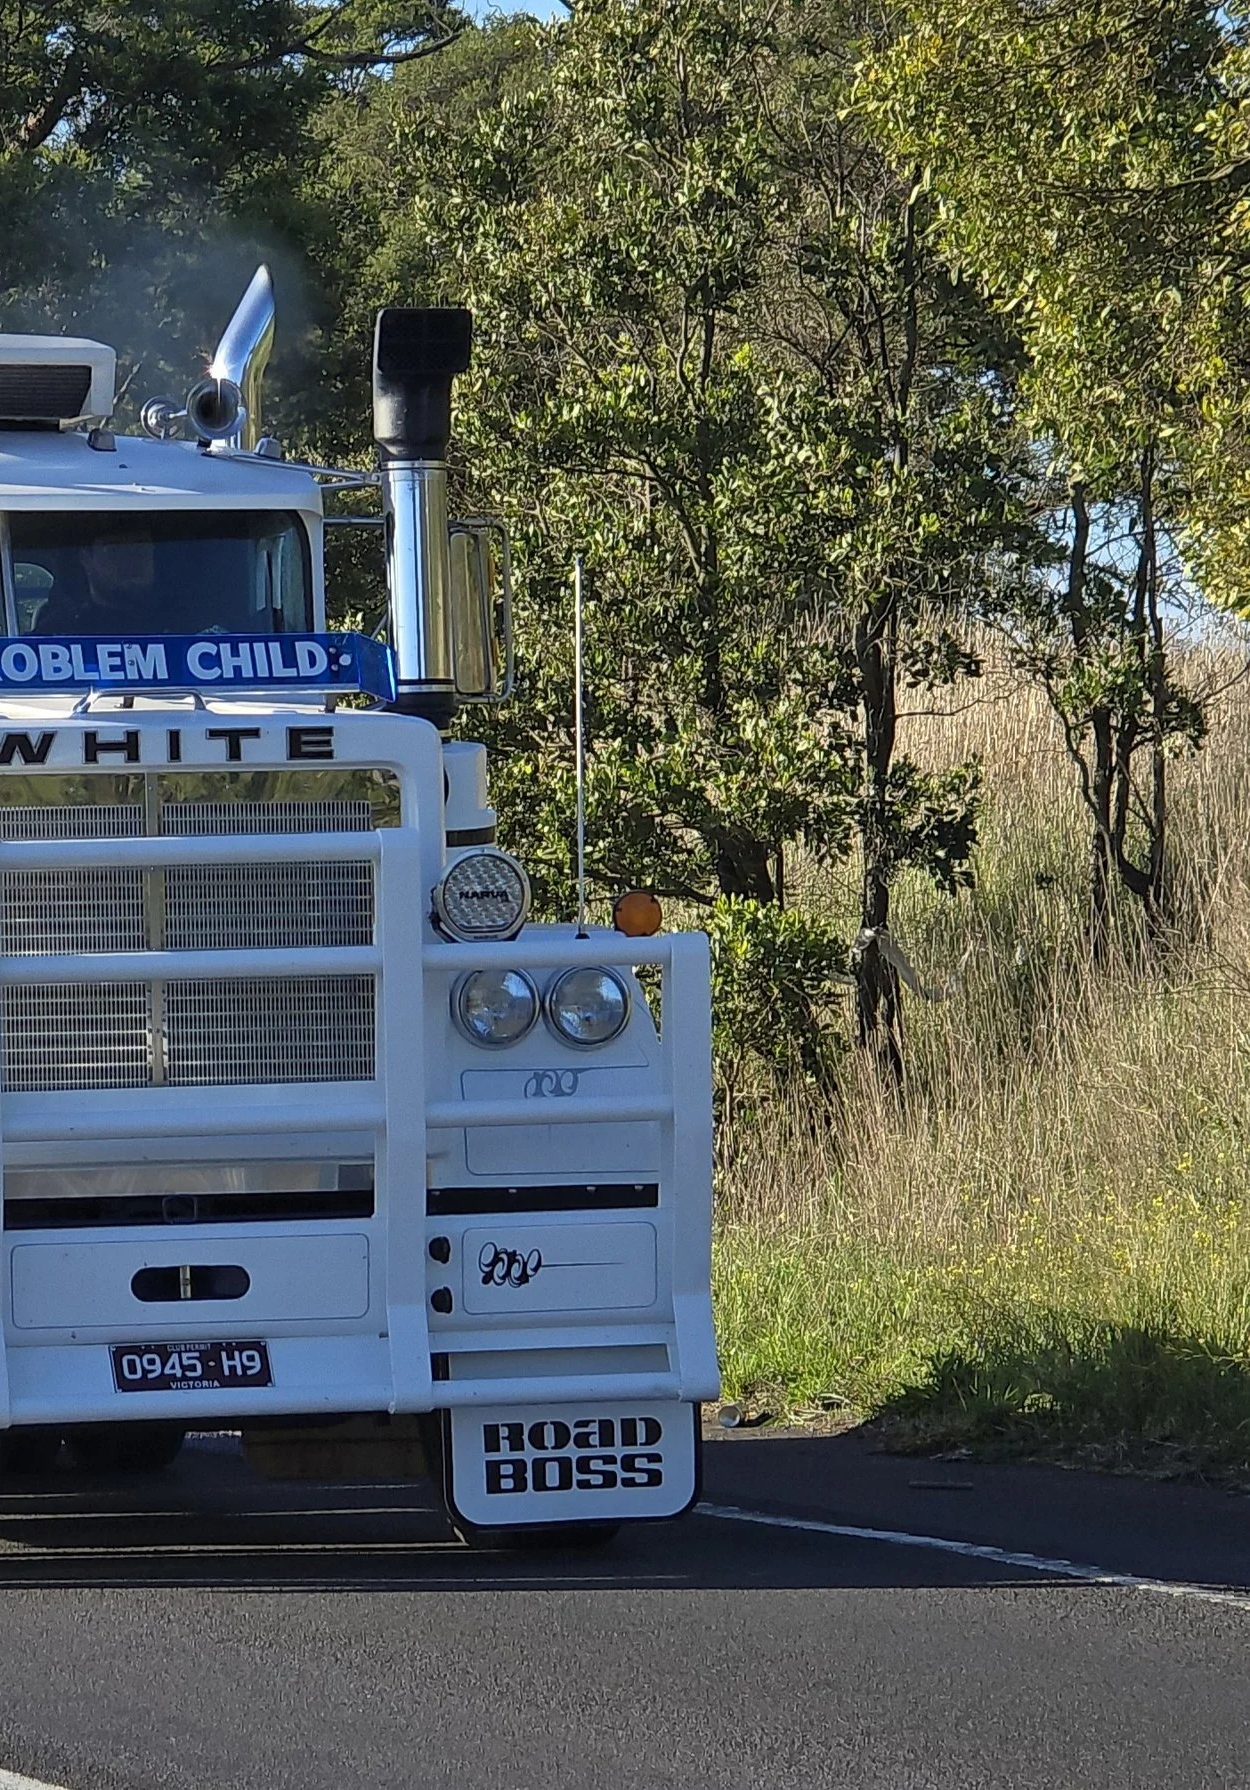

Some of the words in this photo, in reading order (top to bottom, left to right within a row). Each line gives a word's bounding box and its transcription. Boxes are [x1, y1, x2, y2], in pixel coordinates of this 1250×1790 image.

[186, 640, 329, 680] CHILD
[169, 1380, 221, 1390] VICTORIA
[485, 1452, 663, 1495] BOSS
